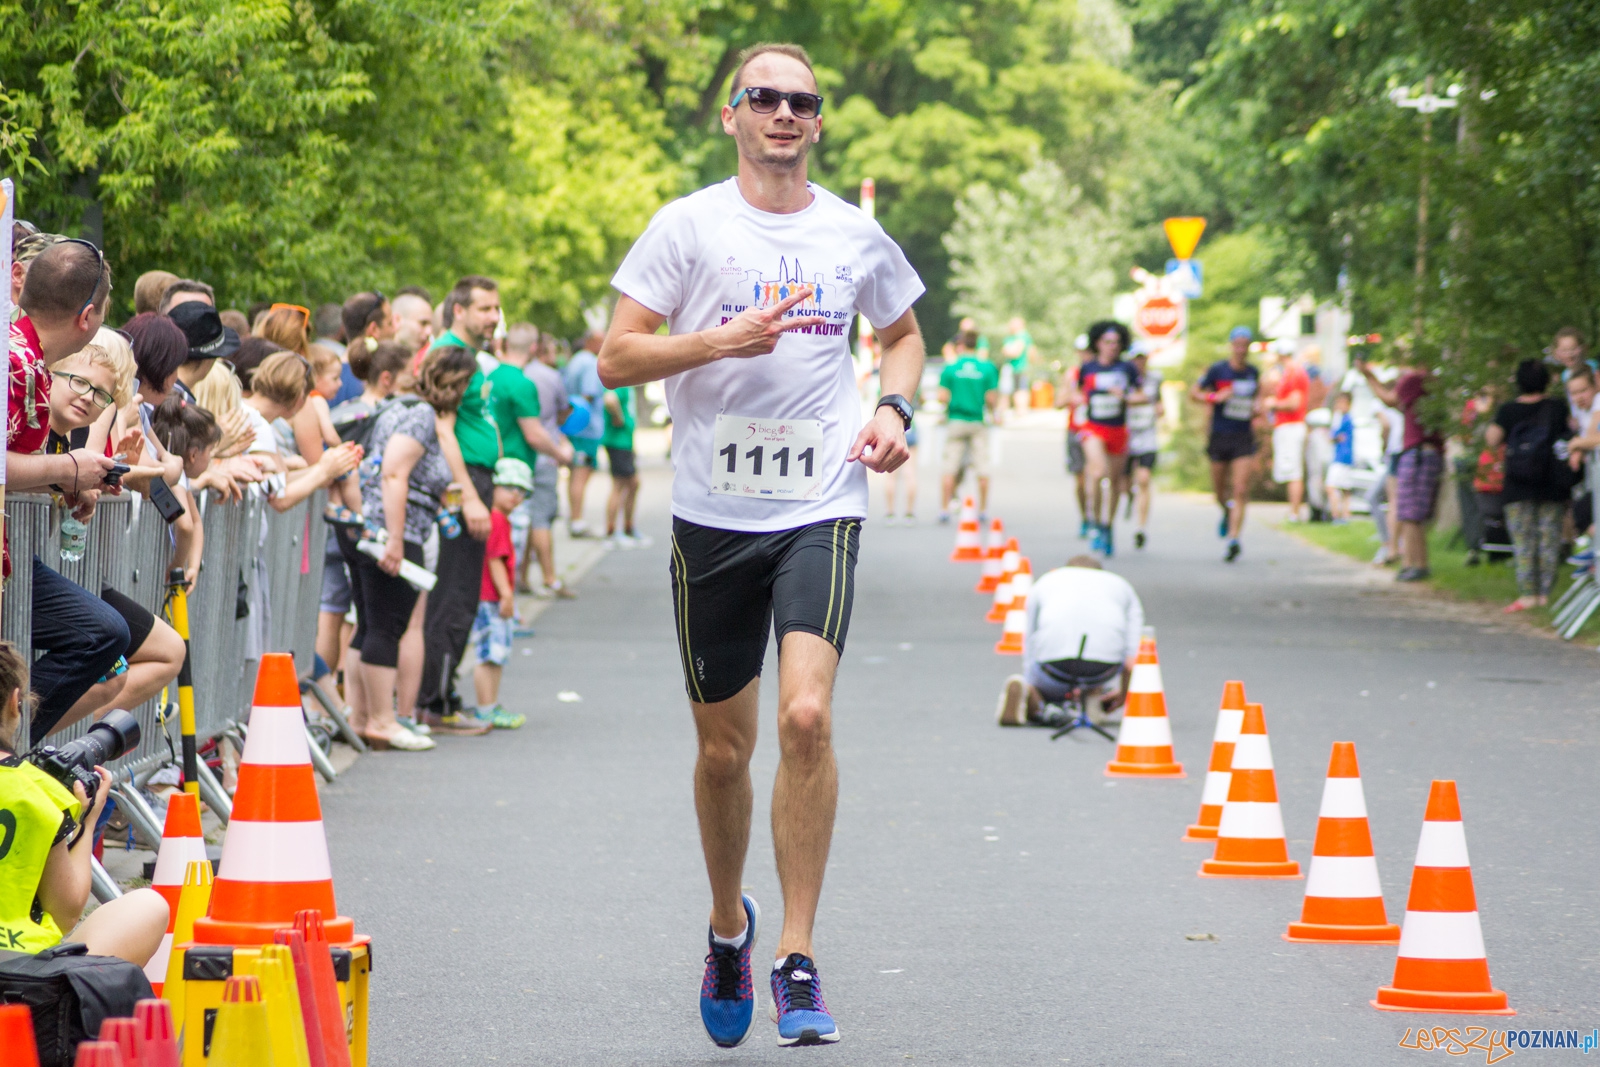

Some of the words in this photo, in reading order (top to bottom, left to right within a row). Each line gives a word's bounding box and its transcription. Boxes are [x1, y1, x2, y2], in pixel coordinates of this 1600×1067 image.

[721, 303, 731, 312] III
[797, 308, 831, 318] KUTNO
[1141, 306, 1176, 326] STOP
[745, 422, 756, 440] 5
[758, 424, 778, 437] bieg
[719, 443, 814, 477] 1111
